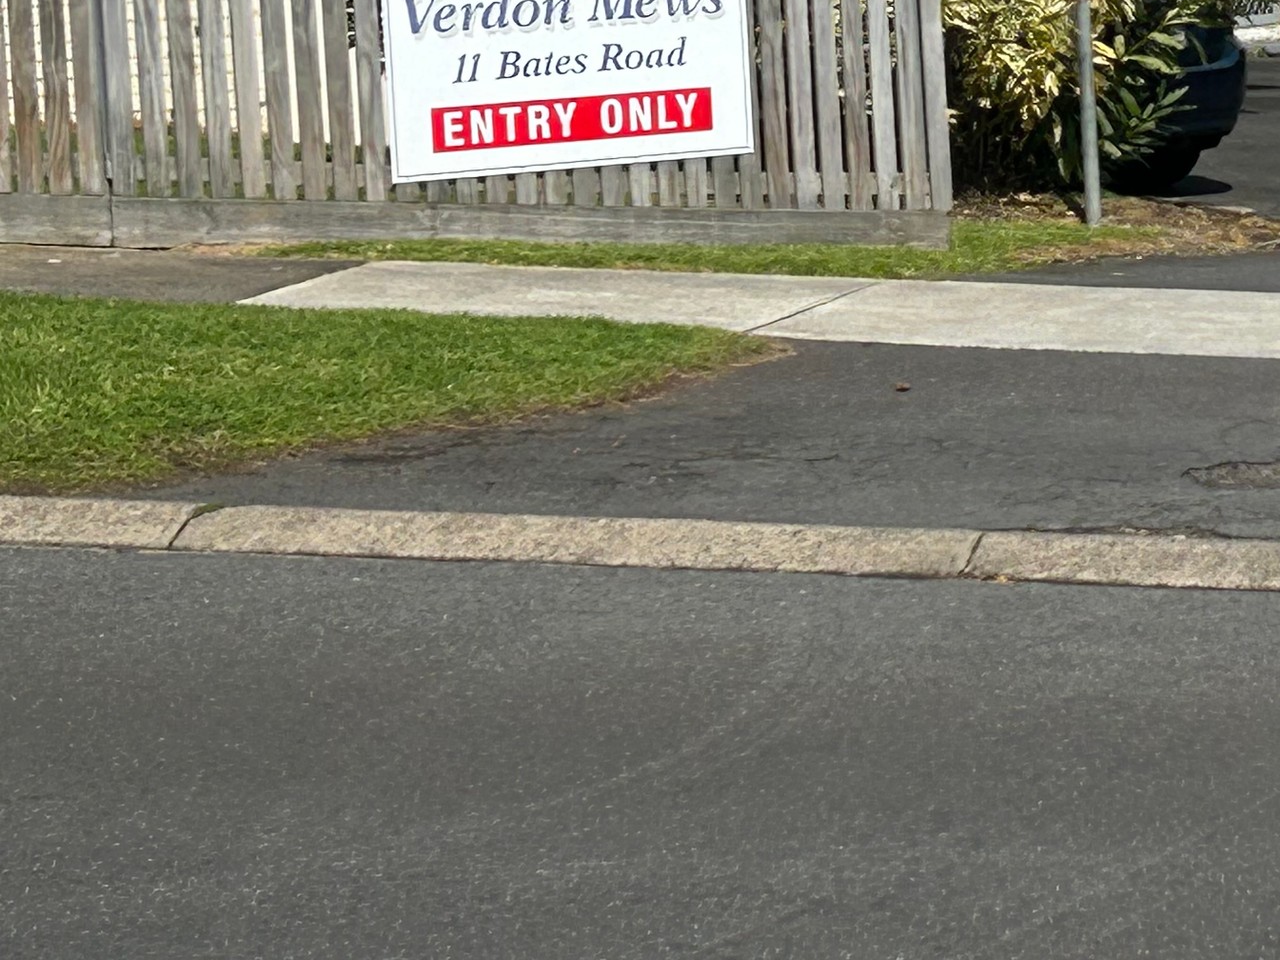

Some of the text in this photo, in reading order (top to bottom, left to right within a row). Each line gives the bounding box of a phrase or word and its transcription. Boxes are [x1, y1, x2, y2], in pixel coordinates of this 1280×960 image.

[452, 36, 688, 84] 11 Bates Road
[443, 92, 698, 147] ENTRY ONLY
